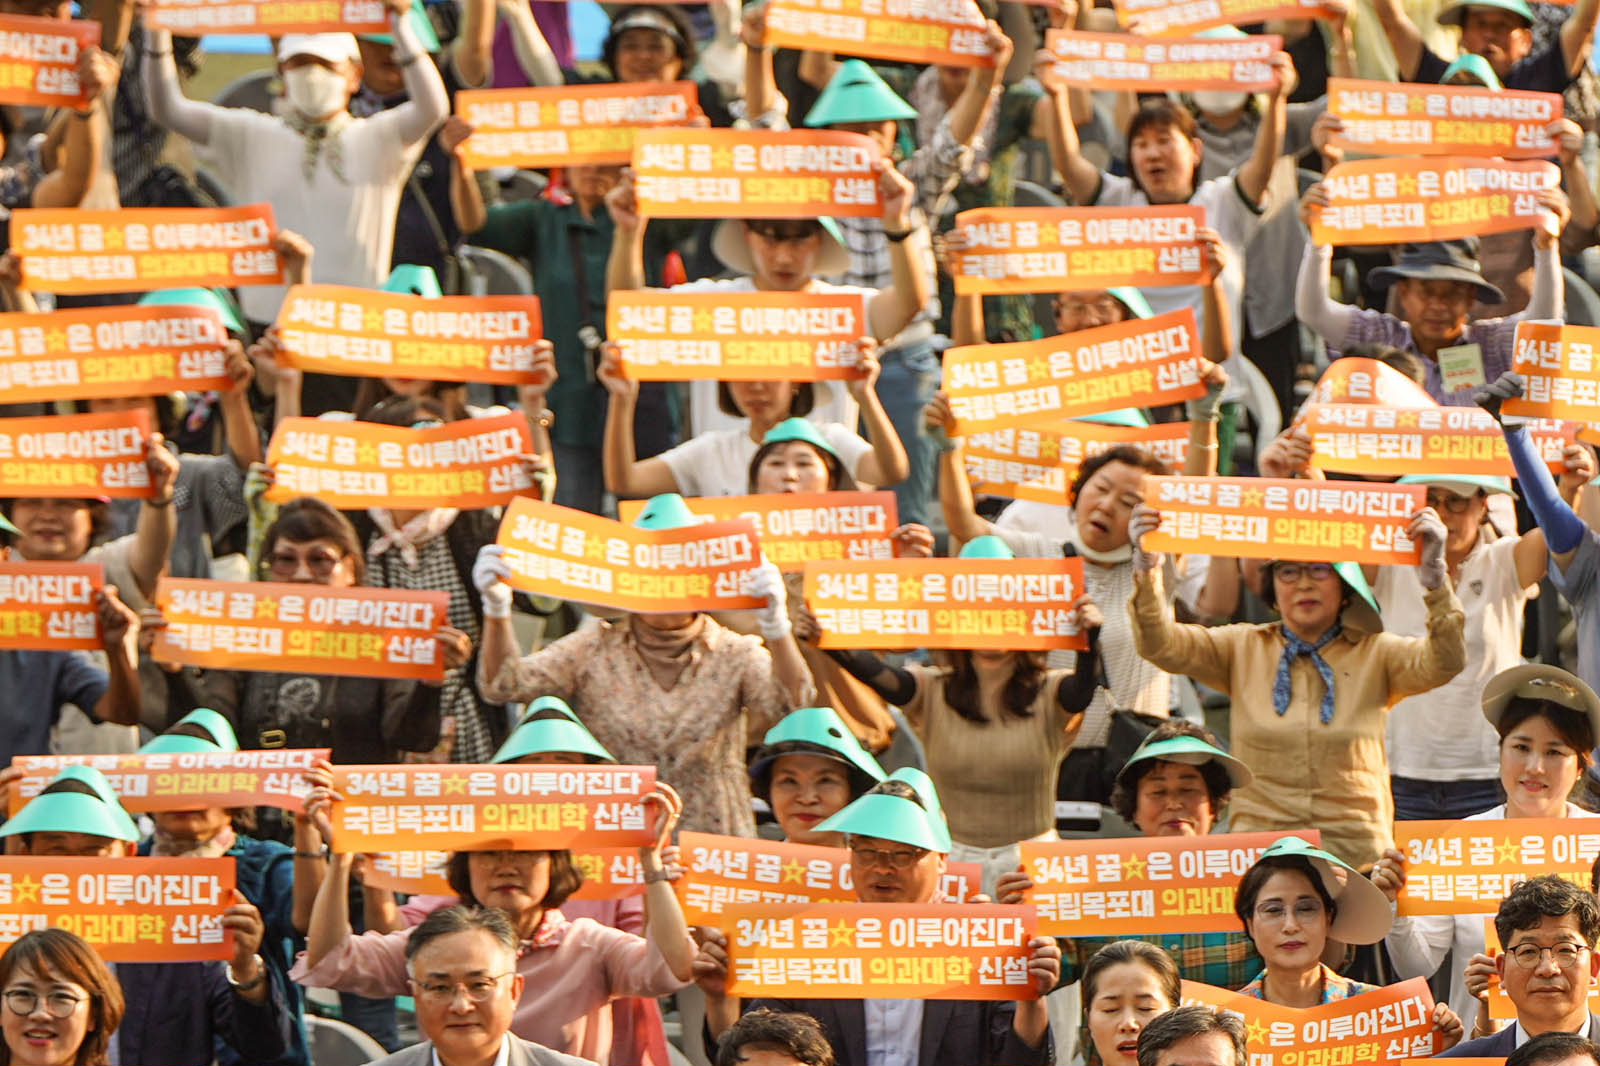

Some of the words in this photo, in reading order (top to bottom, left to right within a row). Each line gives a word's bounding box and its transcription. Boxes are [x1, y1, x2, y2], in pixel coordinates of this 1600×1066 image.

[345, 771, 407, 797] 34년
[503, 771, 643, 796] 이루어진다
[343, 804, 476, 835] 국립목포대
[481, 802, 589, 833] 의과대학
[592, 802, 646, 831] 신설
[736, 918, 795, 949] 34년
[889, 917, 1025, 948] 이루어진다
[735, 957, 863, 985] 국립목포대
[869, 955, 973, 985] 의과대학
[977, 955, 1028, 985] 신설
